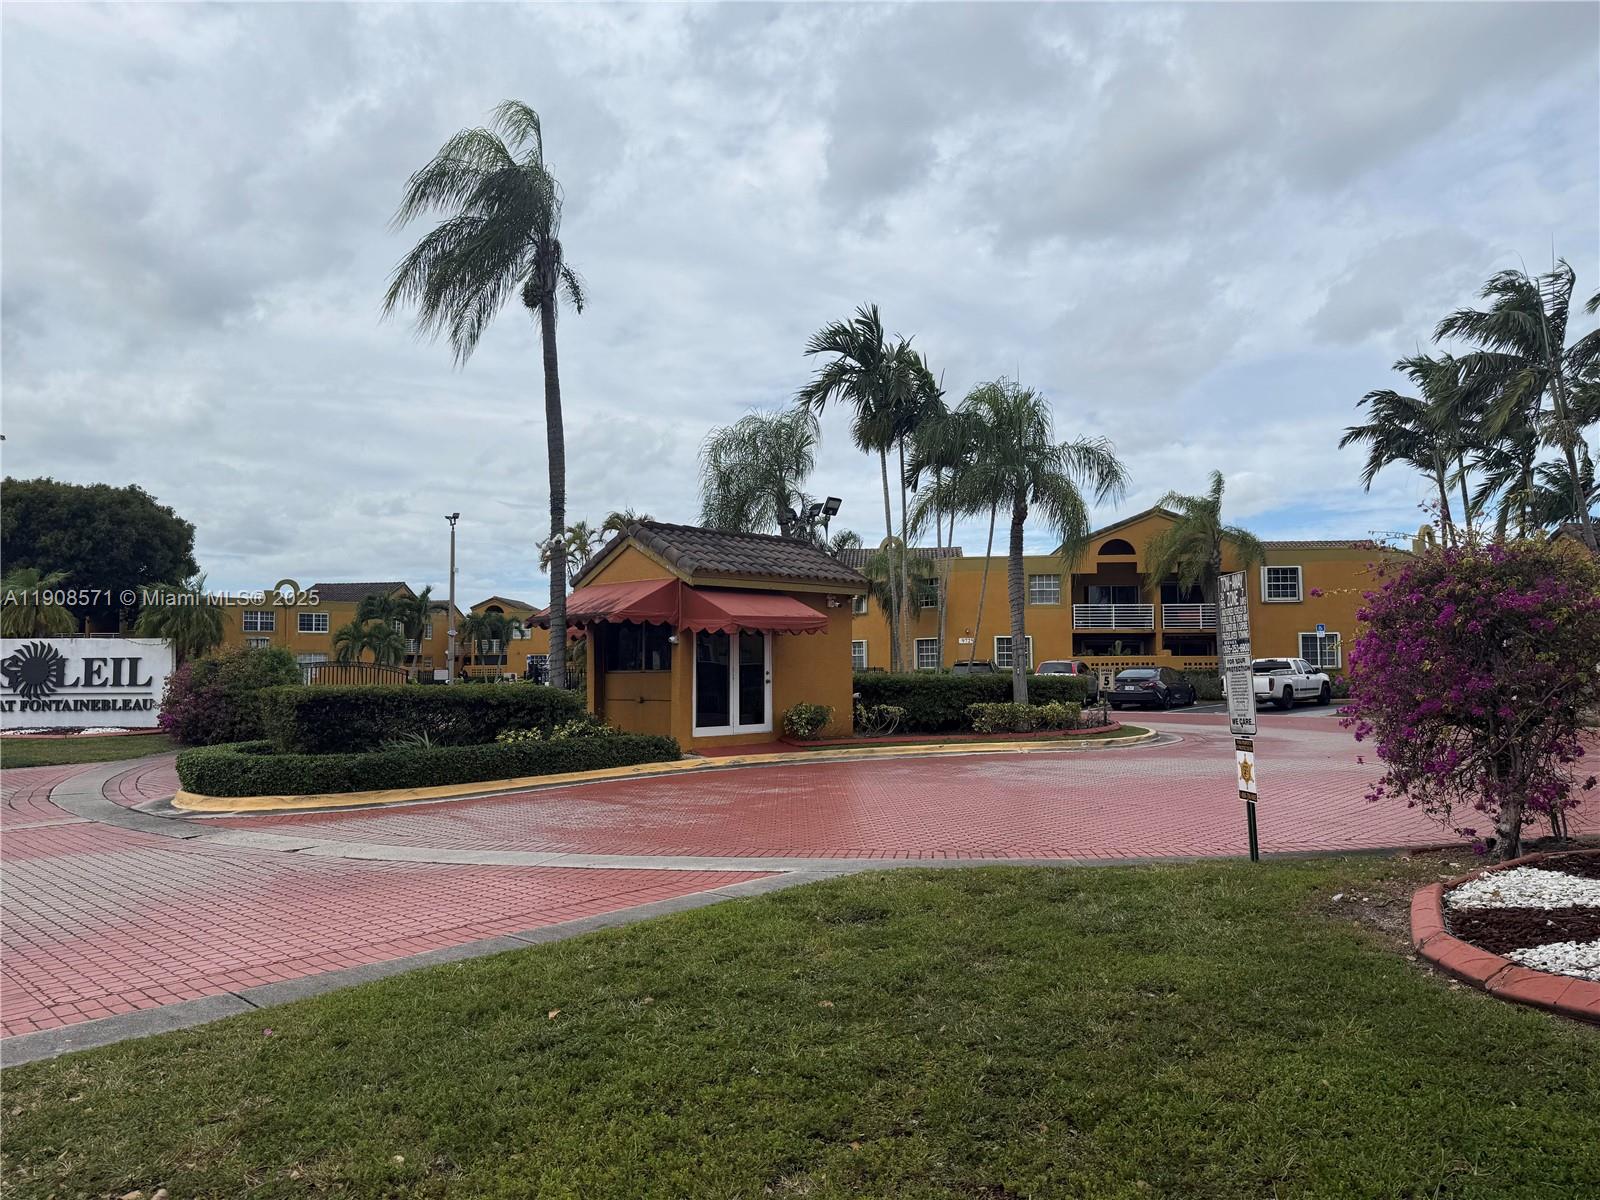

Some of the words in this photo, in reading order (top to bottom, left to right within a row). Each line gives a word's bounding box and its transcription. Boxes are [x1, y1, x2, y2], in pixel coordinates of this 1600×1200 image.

[1235, 657, 1246, 665] YOUR
[1104, 676, 1109, 686] 5
[20, 699, 154, 713] FONTAINEBLEAU
